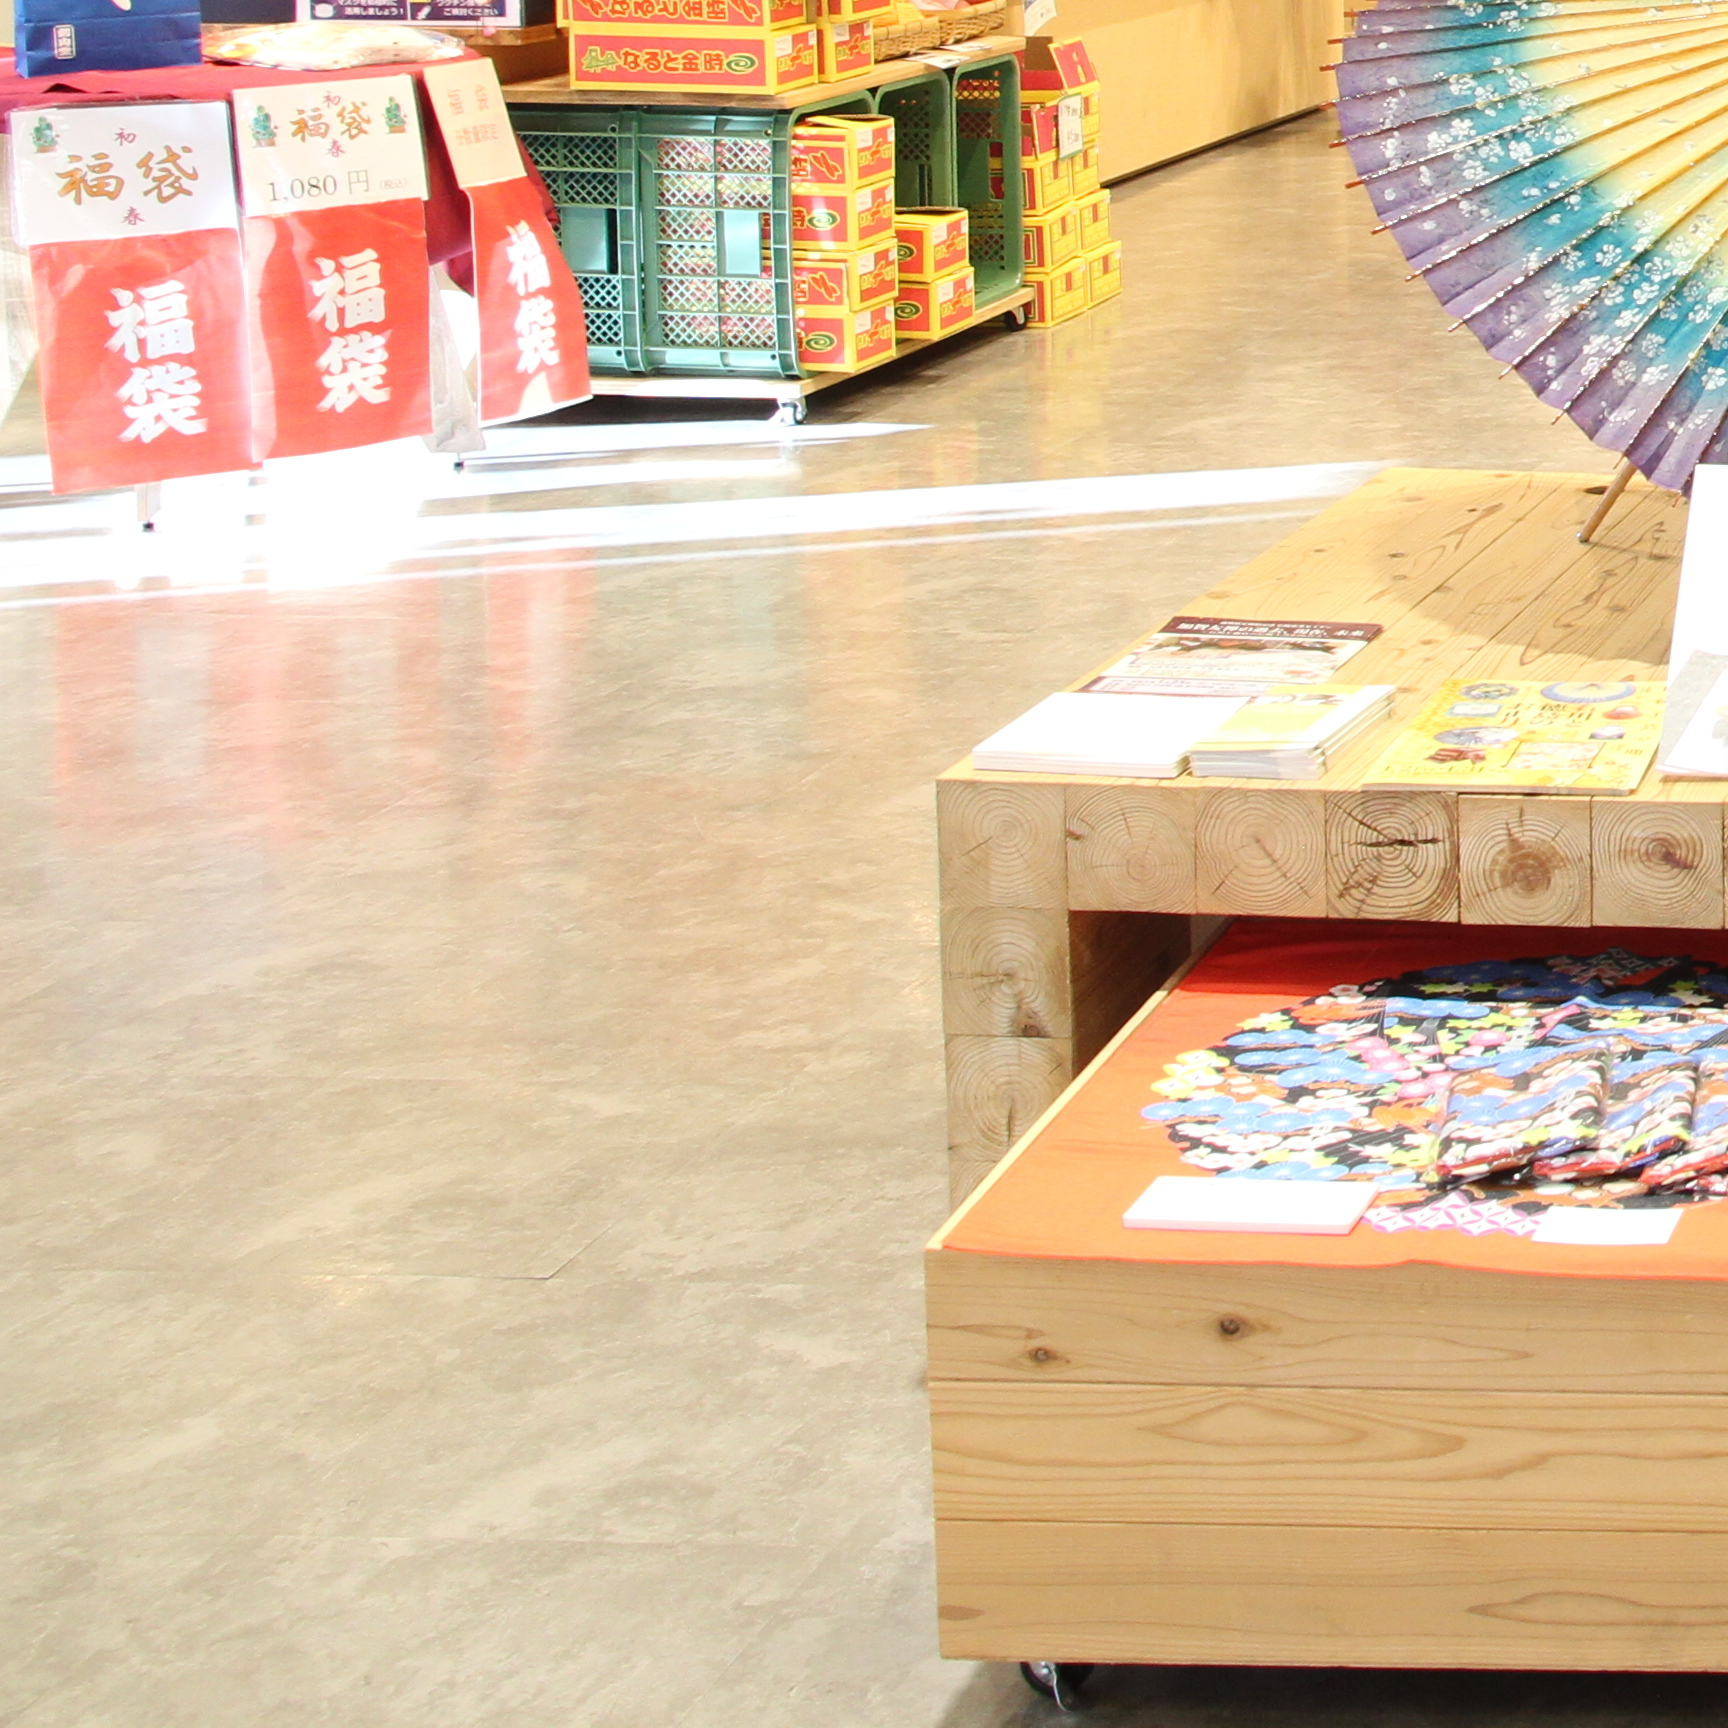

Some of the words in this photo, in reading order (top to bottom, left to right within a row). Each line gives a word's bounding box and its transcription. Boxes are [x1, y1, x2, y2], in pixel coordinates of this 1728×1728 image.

[622, 48, 725, 73] なると金時
[114, 127, 137, 146] 初
[290, 102, 372, 142] 福袋
[326, 139, 346, 158] 春
[56, 146, 198, 205] 福袋
[122, 206, 145, 226] 春
[506, 220, 560, 374] 福袋
[307, 248, 393, 413] 福袋
[105, 280, 208, 443] 福袋
